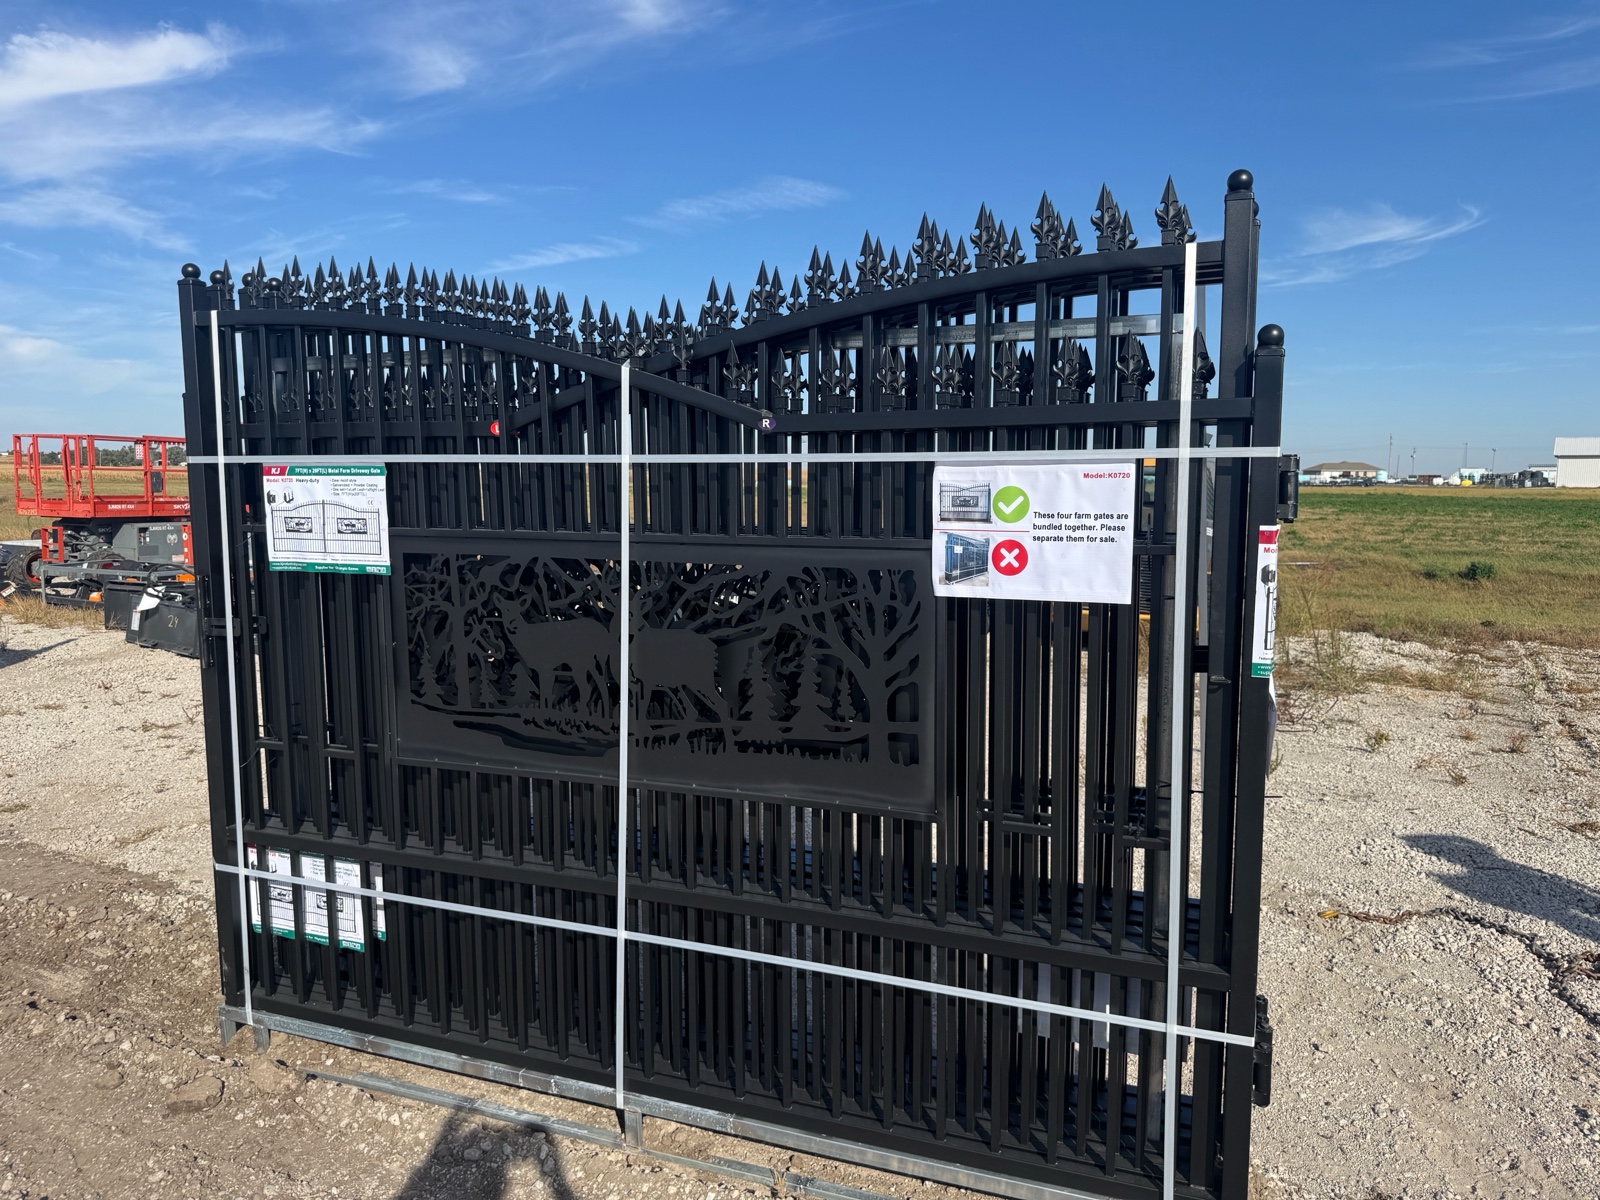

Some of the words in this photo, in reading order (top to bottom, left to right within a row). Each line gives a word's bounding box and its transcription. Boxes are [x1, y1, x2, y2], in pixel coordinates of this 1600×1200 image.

[762, 419, 770, 428] R
[1094, 512, 1114, 521] gates
[1065, 524, 1098, 532] together.
[1032, 535, 1064, 543] separate
